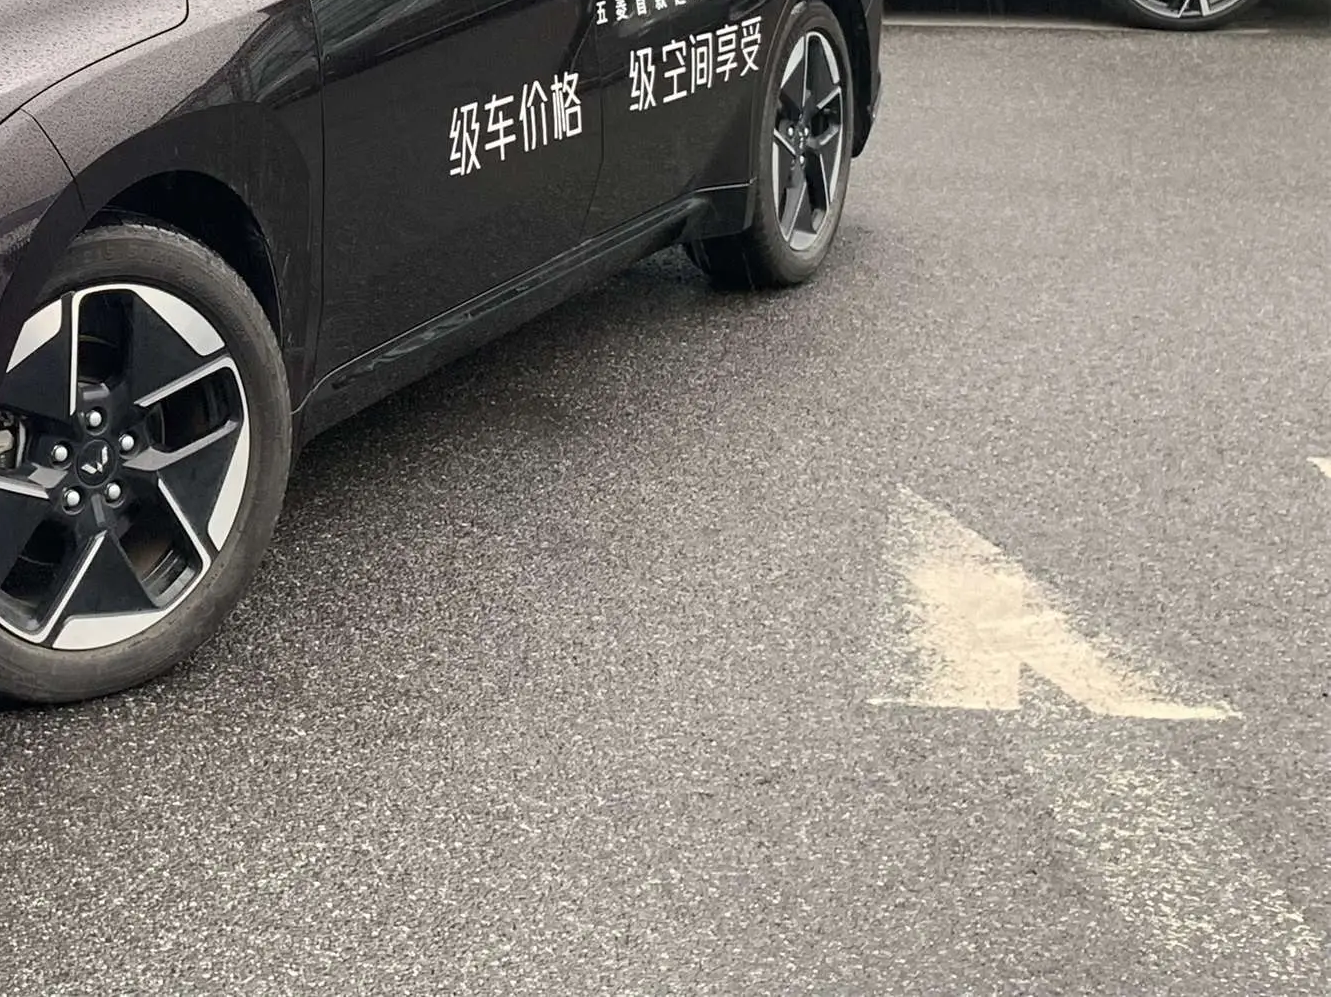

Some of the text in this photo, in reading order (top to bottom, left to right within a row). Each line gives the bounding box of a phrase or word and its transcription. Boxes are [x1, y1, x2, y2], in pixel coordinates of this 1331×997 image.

[449, 16, 762, 176] 级车价格 级空间享受
